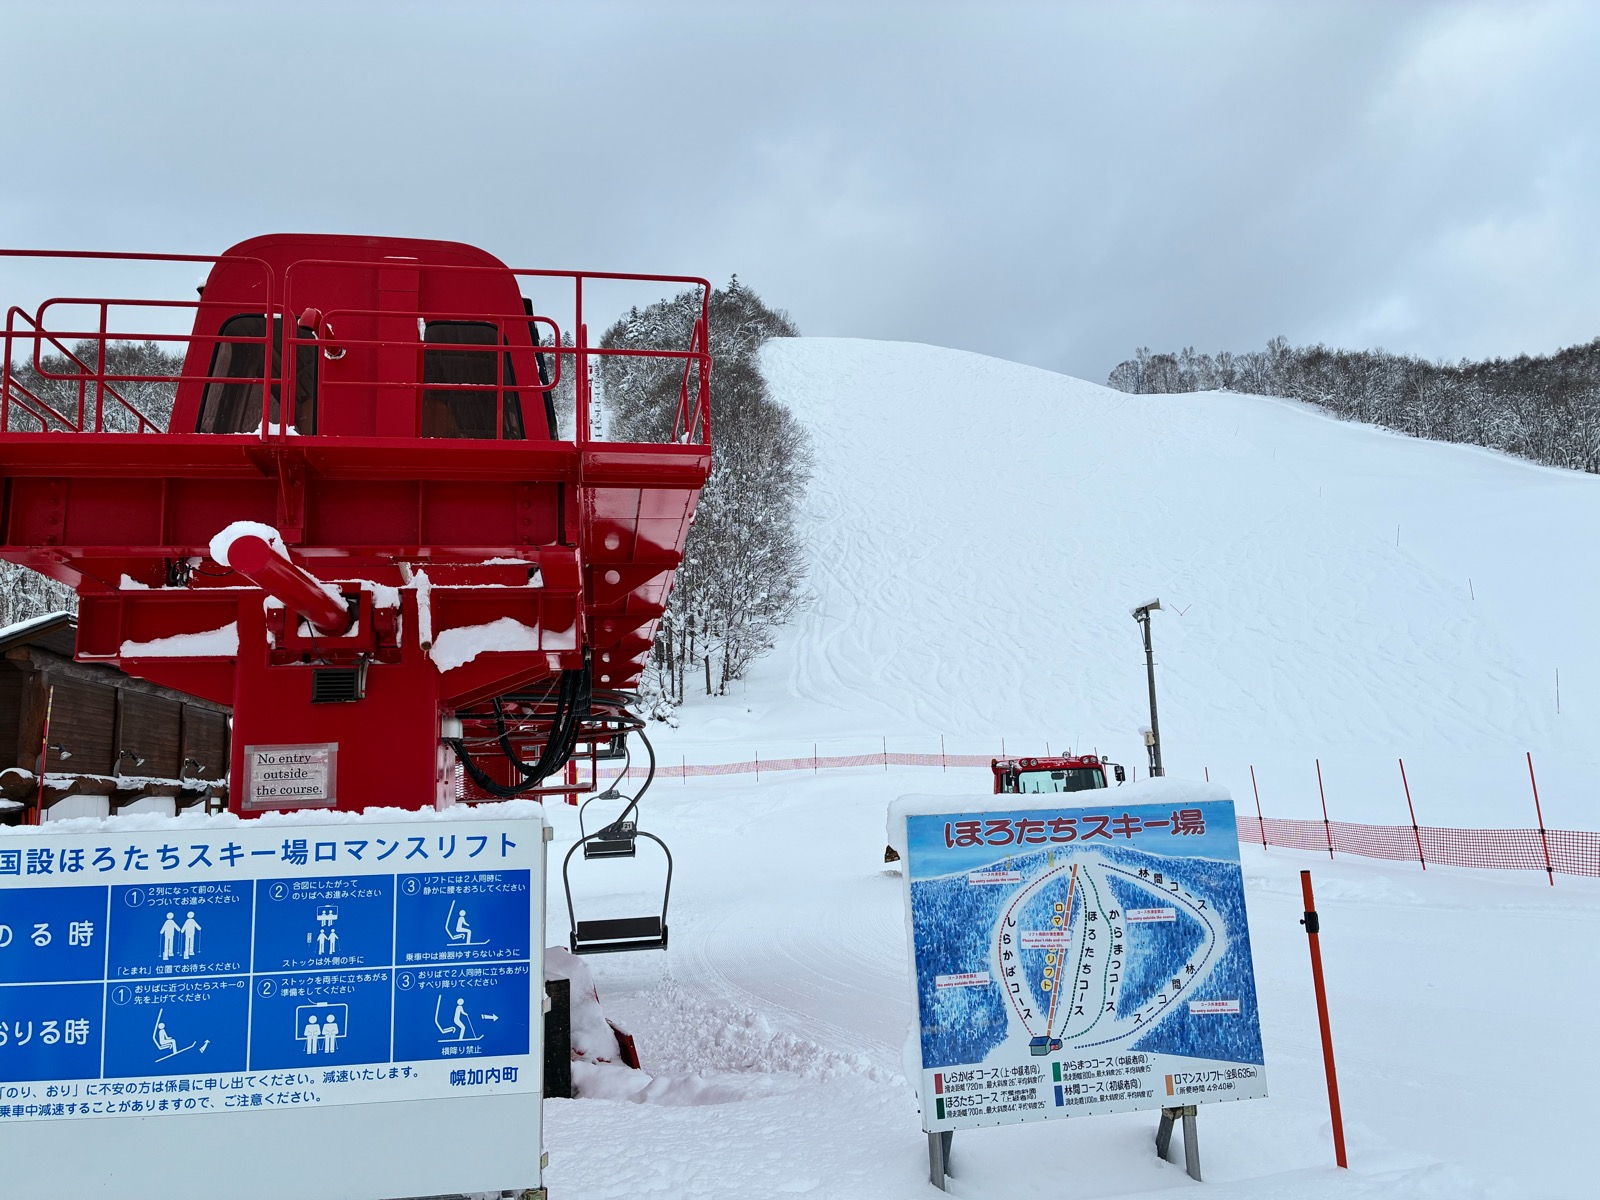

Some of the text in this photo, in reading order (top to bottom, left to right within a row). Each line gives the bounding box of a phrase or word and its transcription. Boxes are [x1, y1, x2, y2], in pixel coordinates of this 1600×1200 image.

[258, 753, 312, 764] No entry
[263, 768, 308, 779] outside
[256, 784, 322, 796] the course.
[944, 808, 1206, 848] ほろたちスキー場
[0, 832, 517, 876] 国設ほろたちスキー場ロマンスリフト
[292, 880, 358, 890] 合図にしたがって
[424, 874, 502, 885] リフトには2人同時に
[148, 885, 231, 896] 2列になって前の人に
[292, 889, 382, 900] のりばへお進みください
[423, 884, 526, 896] 静かに腰をおろしてください
[147, 895, 240, 907] つづいてお進みください
[1042, 902, 1064, 991] ロマリフト
[406, 949, 520, 962] 乗車中は搬器ゆすらないように
[1105, 909, 1124, 1012] からまつコース
[282, 956, 364, 968] ストックは外側の手に
[1003, 916, 1033, 1020] しらかばコース
[1074, 911, 1098, 1016] ほろたちコース
[117, 962, 241, 976] 「とまれ」位置でお待ちください
[418, 966, 528, 980] おりばで2人同時に立ちあがり
[281, 973, 388, 986] ストックを両手に立ちあがる
[418, 978, 498, 989] すべり降りてください
[134, 980, 245, 994] おりばに近づいたらスキーの
[281, 985, 356, 997] 準備をしてください
[134, 993, 211, 1005] 先を上げてください
[441, 1045, 482, 1057] 横降り禁止
[449, 1066, 519, 1087] 幌加内町
